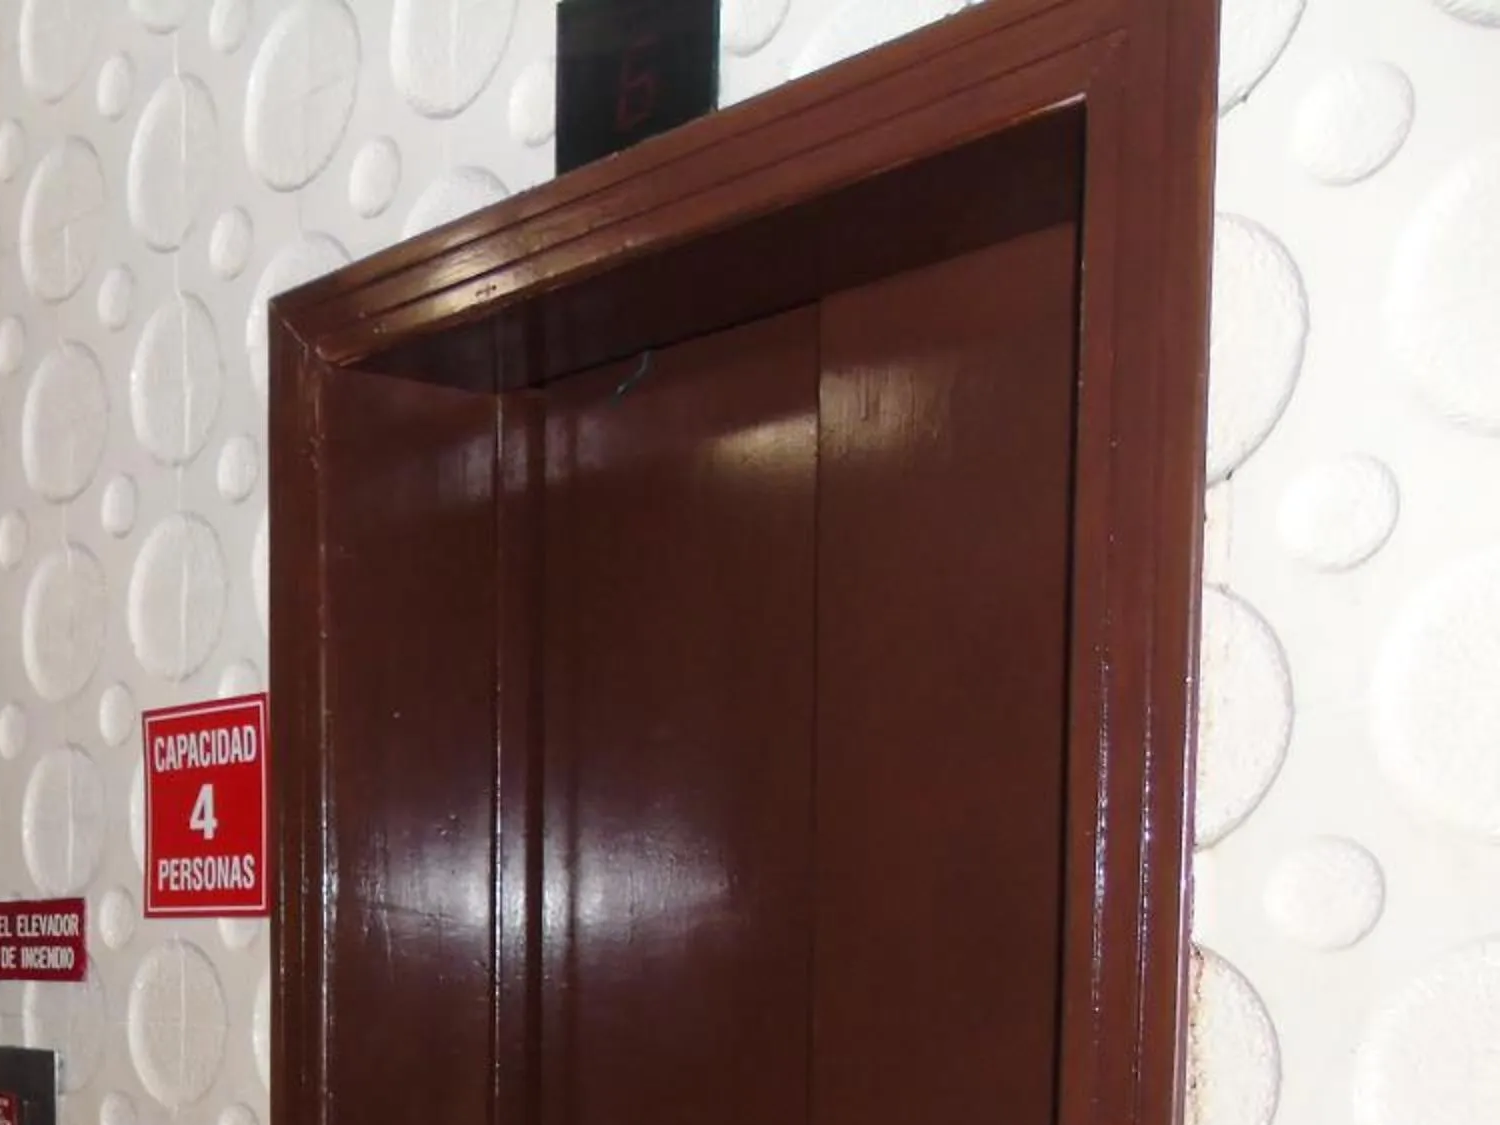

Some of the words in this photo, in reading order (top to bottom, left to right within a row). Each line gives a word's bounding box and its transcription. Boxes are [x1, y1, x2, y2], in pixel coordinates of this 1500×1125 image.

[154, 726, 256, 772] CAPACIDAD
[189, 783, 218, 840] 4
[158, 854, 255, 892] PERSONAS
[16, 913, 79, 937] ELEVADOR
[1, 946, 17, 968] DE
[21, 946, 75, 970] INCENDIO
